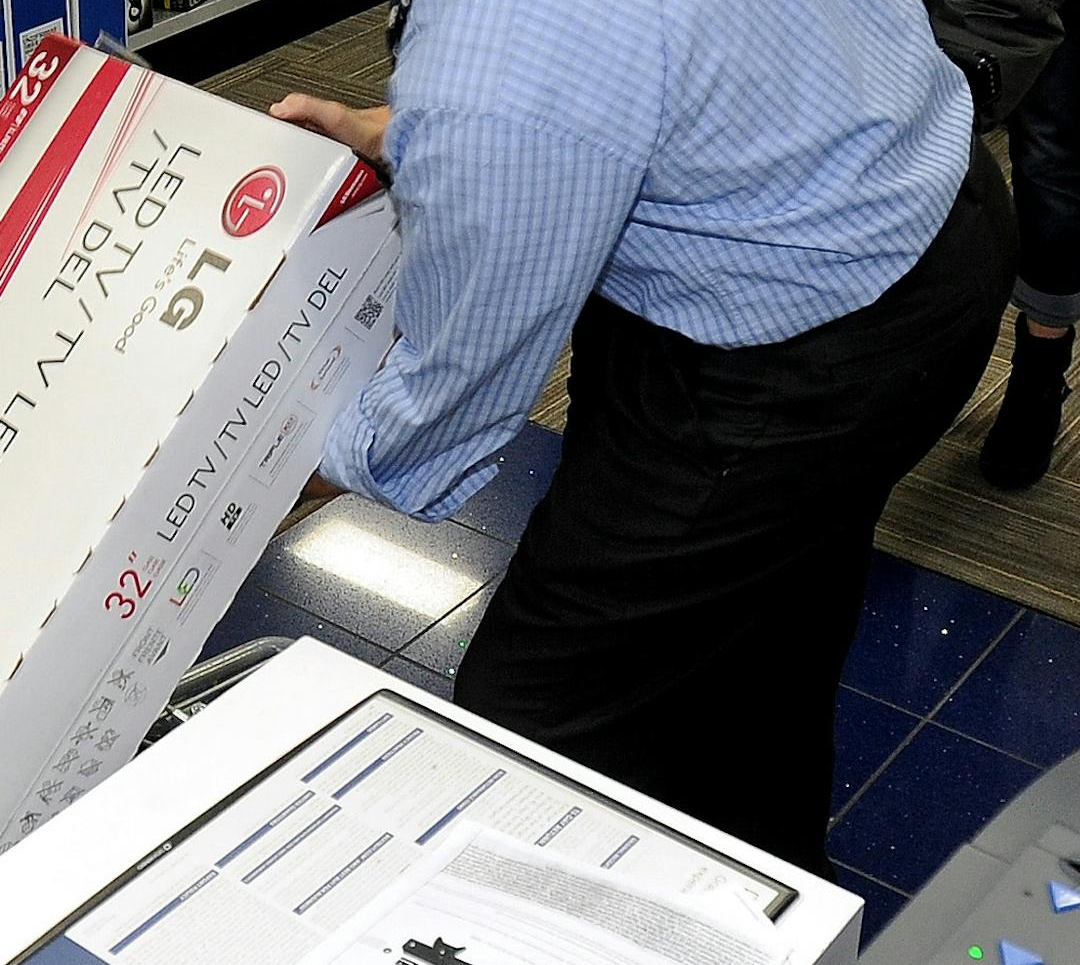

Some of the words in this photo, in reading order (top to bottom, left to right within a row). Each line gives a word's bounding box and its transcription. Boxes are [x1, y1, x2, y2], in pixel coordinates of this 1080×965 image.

[112, 157, 160, 215] TV
[134, 143, 202, 228] LED
[42, 218, 113, 301] DEL
[95, 239, 144, 299] TV
[153, 238, 198, 293] Life's
[78, 297, 94, 323] /
[158, 245, 233, 331] LG
[307, 266, 348, 312] DEL
[114, 294, 158, 356] Good
[283, 309, 311, 343] TV
[36, 329, 85, 388] TV
[277, 341, 292, 363] /
[242, 358, 282, 409] LED
[212, 440, 228, 461] /
[218, 407, 247, 442] TV
[187, 455, 218, 489] TV
[156, 492, 197, 544] LED
[218, 501, 237, 525] HD
[104, 550, 155, 620] 32"
